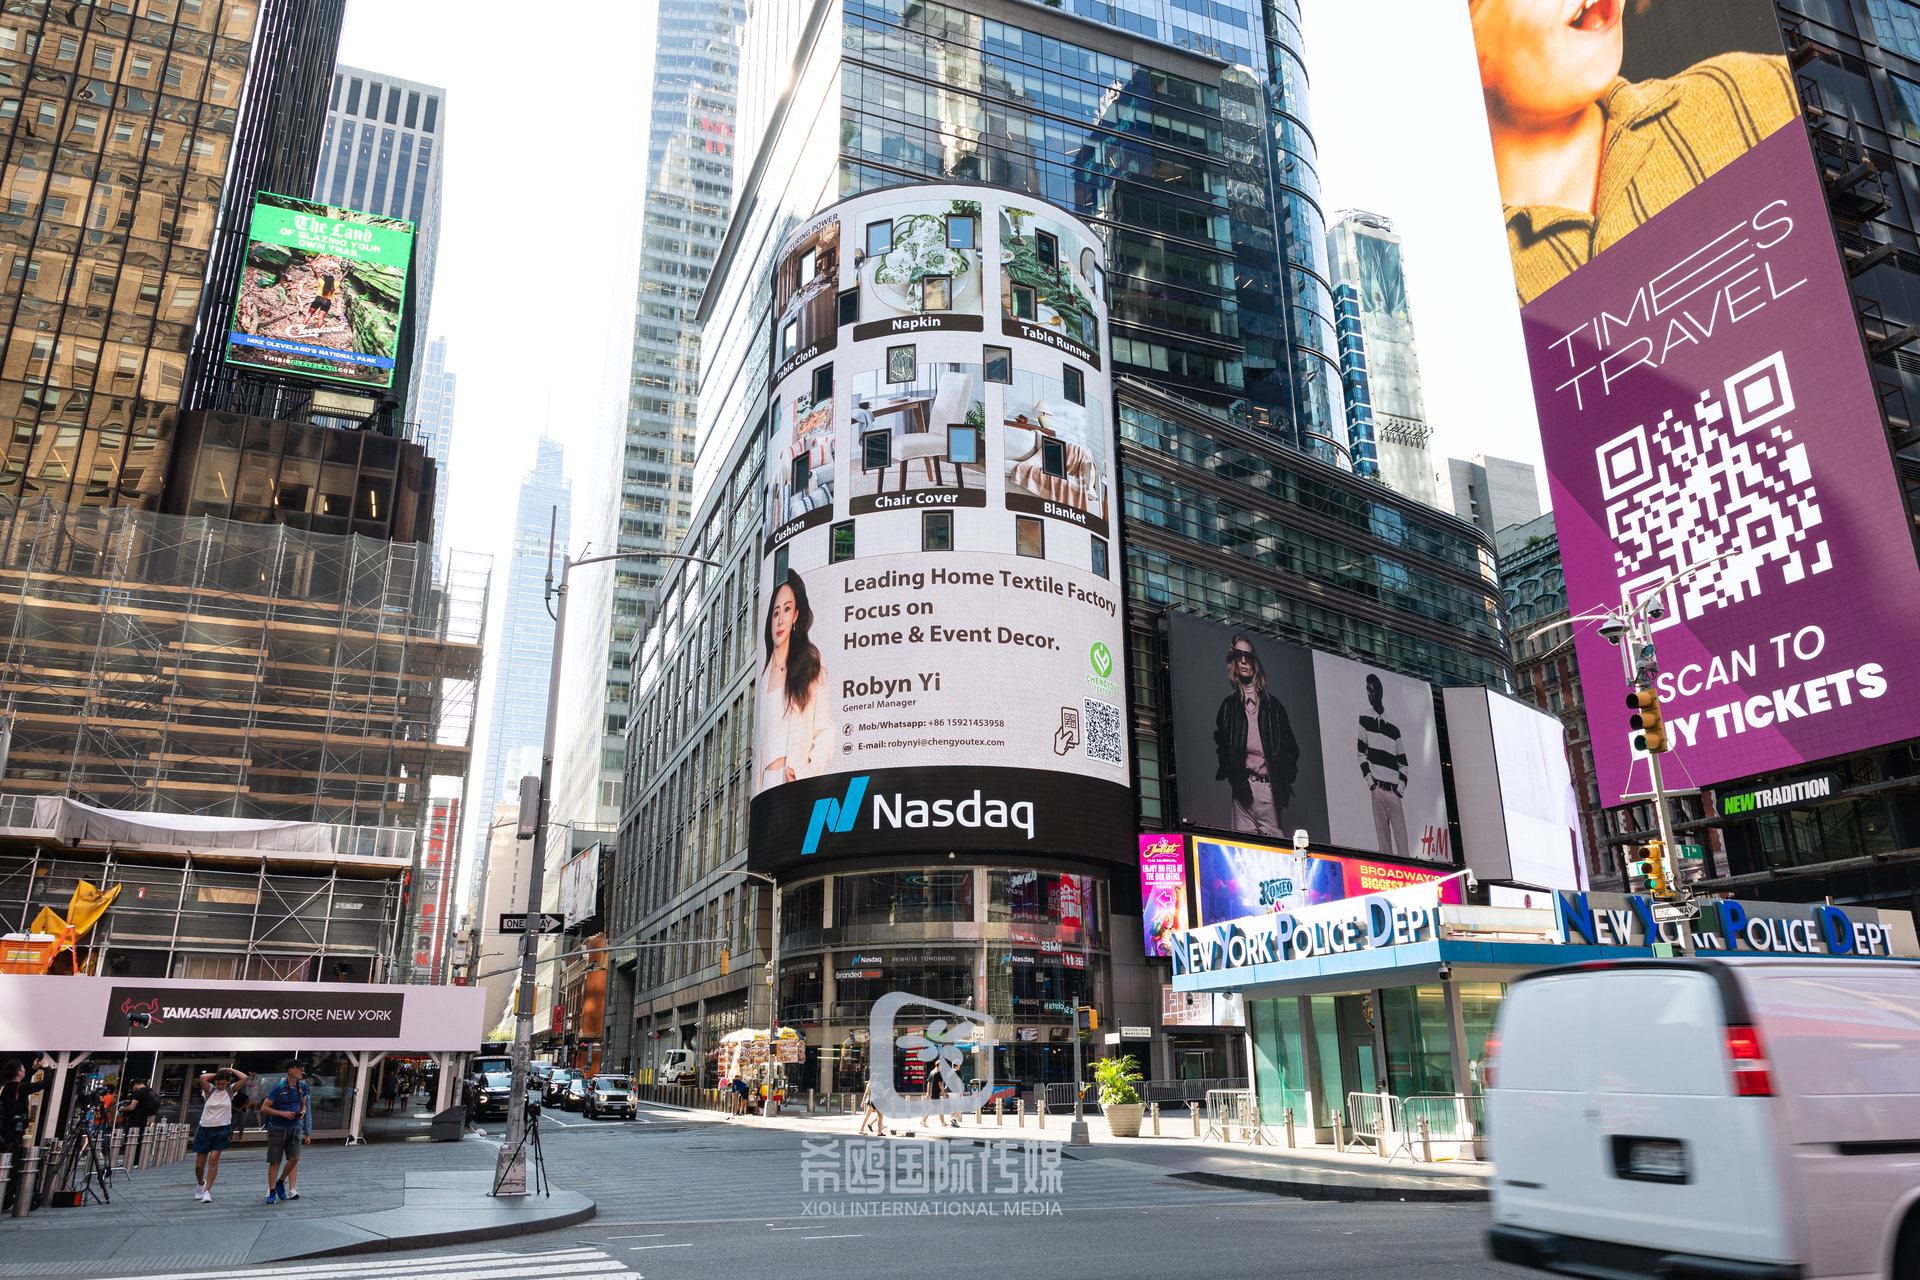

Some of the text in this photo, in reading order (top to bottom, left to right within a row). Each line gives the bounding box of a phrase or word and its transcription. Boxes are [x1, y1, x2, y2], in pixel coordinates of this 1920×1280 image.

[294, 214, 373, 243] The Land
[812, 213, 838, 233] POWER
[280, 228, 381, 254] OF BLAZING YOUR
[298, 240, 361, 258] OWN TRAIL
[1548, 199, 1796, 367] TIMES
[284, 323, 348, 339] Cleveland
[892, 316, 941, 331] Napkin
[1555, 261, 1808, 411] TRAVEL
[246, 338, 377, 364] HIKE CLEVELAND'S NATIONAL PARK
[1021, 326, 1091, 361] Table Runner
[777, 346, 818, 382] Table Cloth
[875, 492, 958, 508] Chair Cover
[1043, 502, 1086, 524] Blanket
[773, 519, 805, 544] Cushion
[844, 569, 1117, 617] Leading Home Textile Factory
[844, 601, 933, 622] Focus on
[844, 626, 1060, 651] Home & Event Decor.
[1657, 624, 1826, 702] SCAN TO
[843, 673, 941, 699] Robyn Yi
[1094, 685, 1112, 696] TEXTILE
[843, 699, 917, 712] General Manager
[1705, 662, 1888, 742] TICKETS
[858, 718, 1005, 732] Mob/Whatsapp: +86 15921453958
[858, 738, 1005, 750] E-mail: robynyi@chengyoutex.com
[873, 789, 1035, 840] Nasdaq
[426, 807, 447, 867] PARK
[1421, 825, 1449, 860] H&M
[1177, 864, 1182, 872] AT
[1259, 878, 1293, 906] ROMEO
[506, 920, 524, 928] ONE
[1556, 891, 1633, 946] NEW
[1717, 899, 1820, 953] POLICE
[1818, 904, 1894, 956] DEPT
[1657, 906, 1693, 917] ONE WAY
[415, 904, 436, 966] PARK
[1171, 896, 1443, 975] NEW YORK POLICE DEPT
[861, 956, 882, 964] Nasdaq
[1012, 956, 1035, 964] Nasdaq
[162, 1007, 221, 1019] TAMASHII
[282, 1009, 323, 1021] STORE
[326, 1009, 356, 1020] NEW
[357, 1009, 392, 1021] YORK
